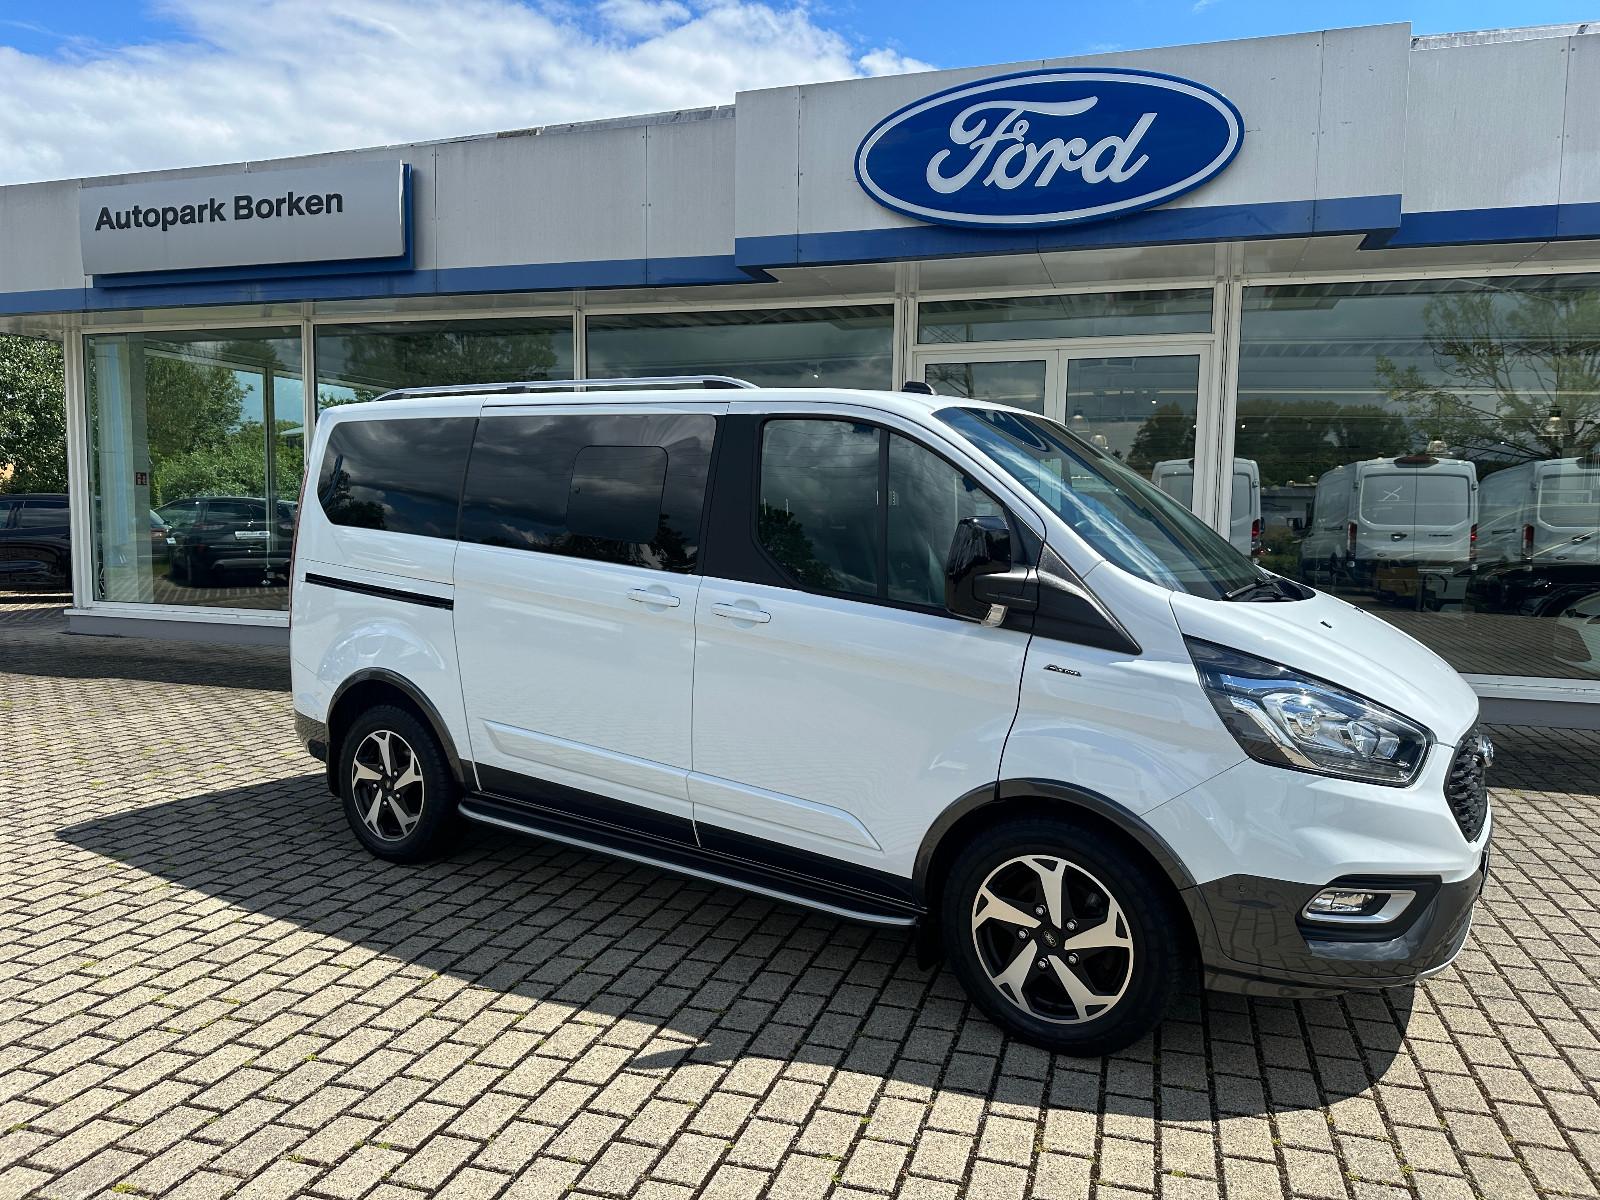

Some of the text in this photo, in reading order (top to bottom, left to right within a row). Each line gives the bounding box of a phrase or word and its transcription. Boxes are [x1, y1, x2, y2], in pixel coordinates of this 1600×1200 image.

[925, 96, 1158, 194] Ford
[95, 191, 344, 231] Autopark Borken
